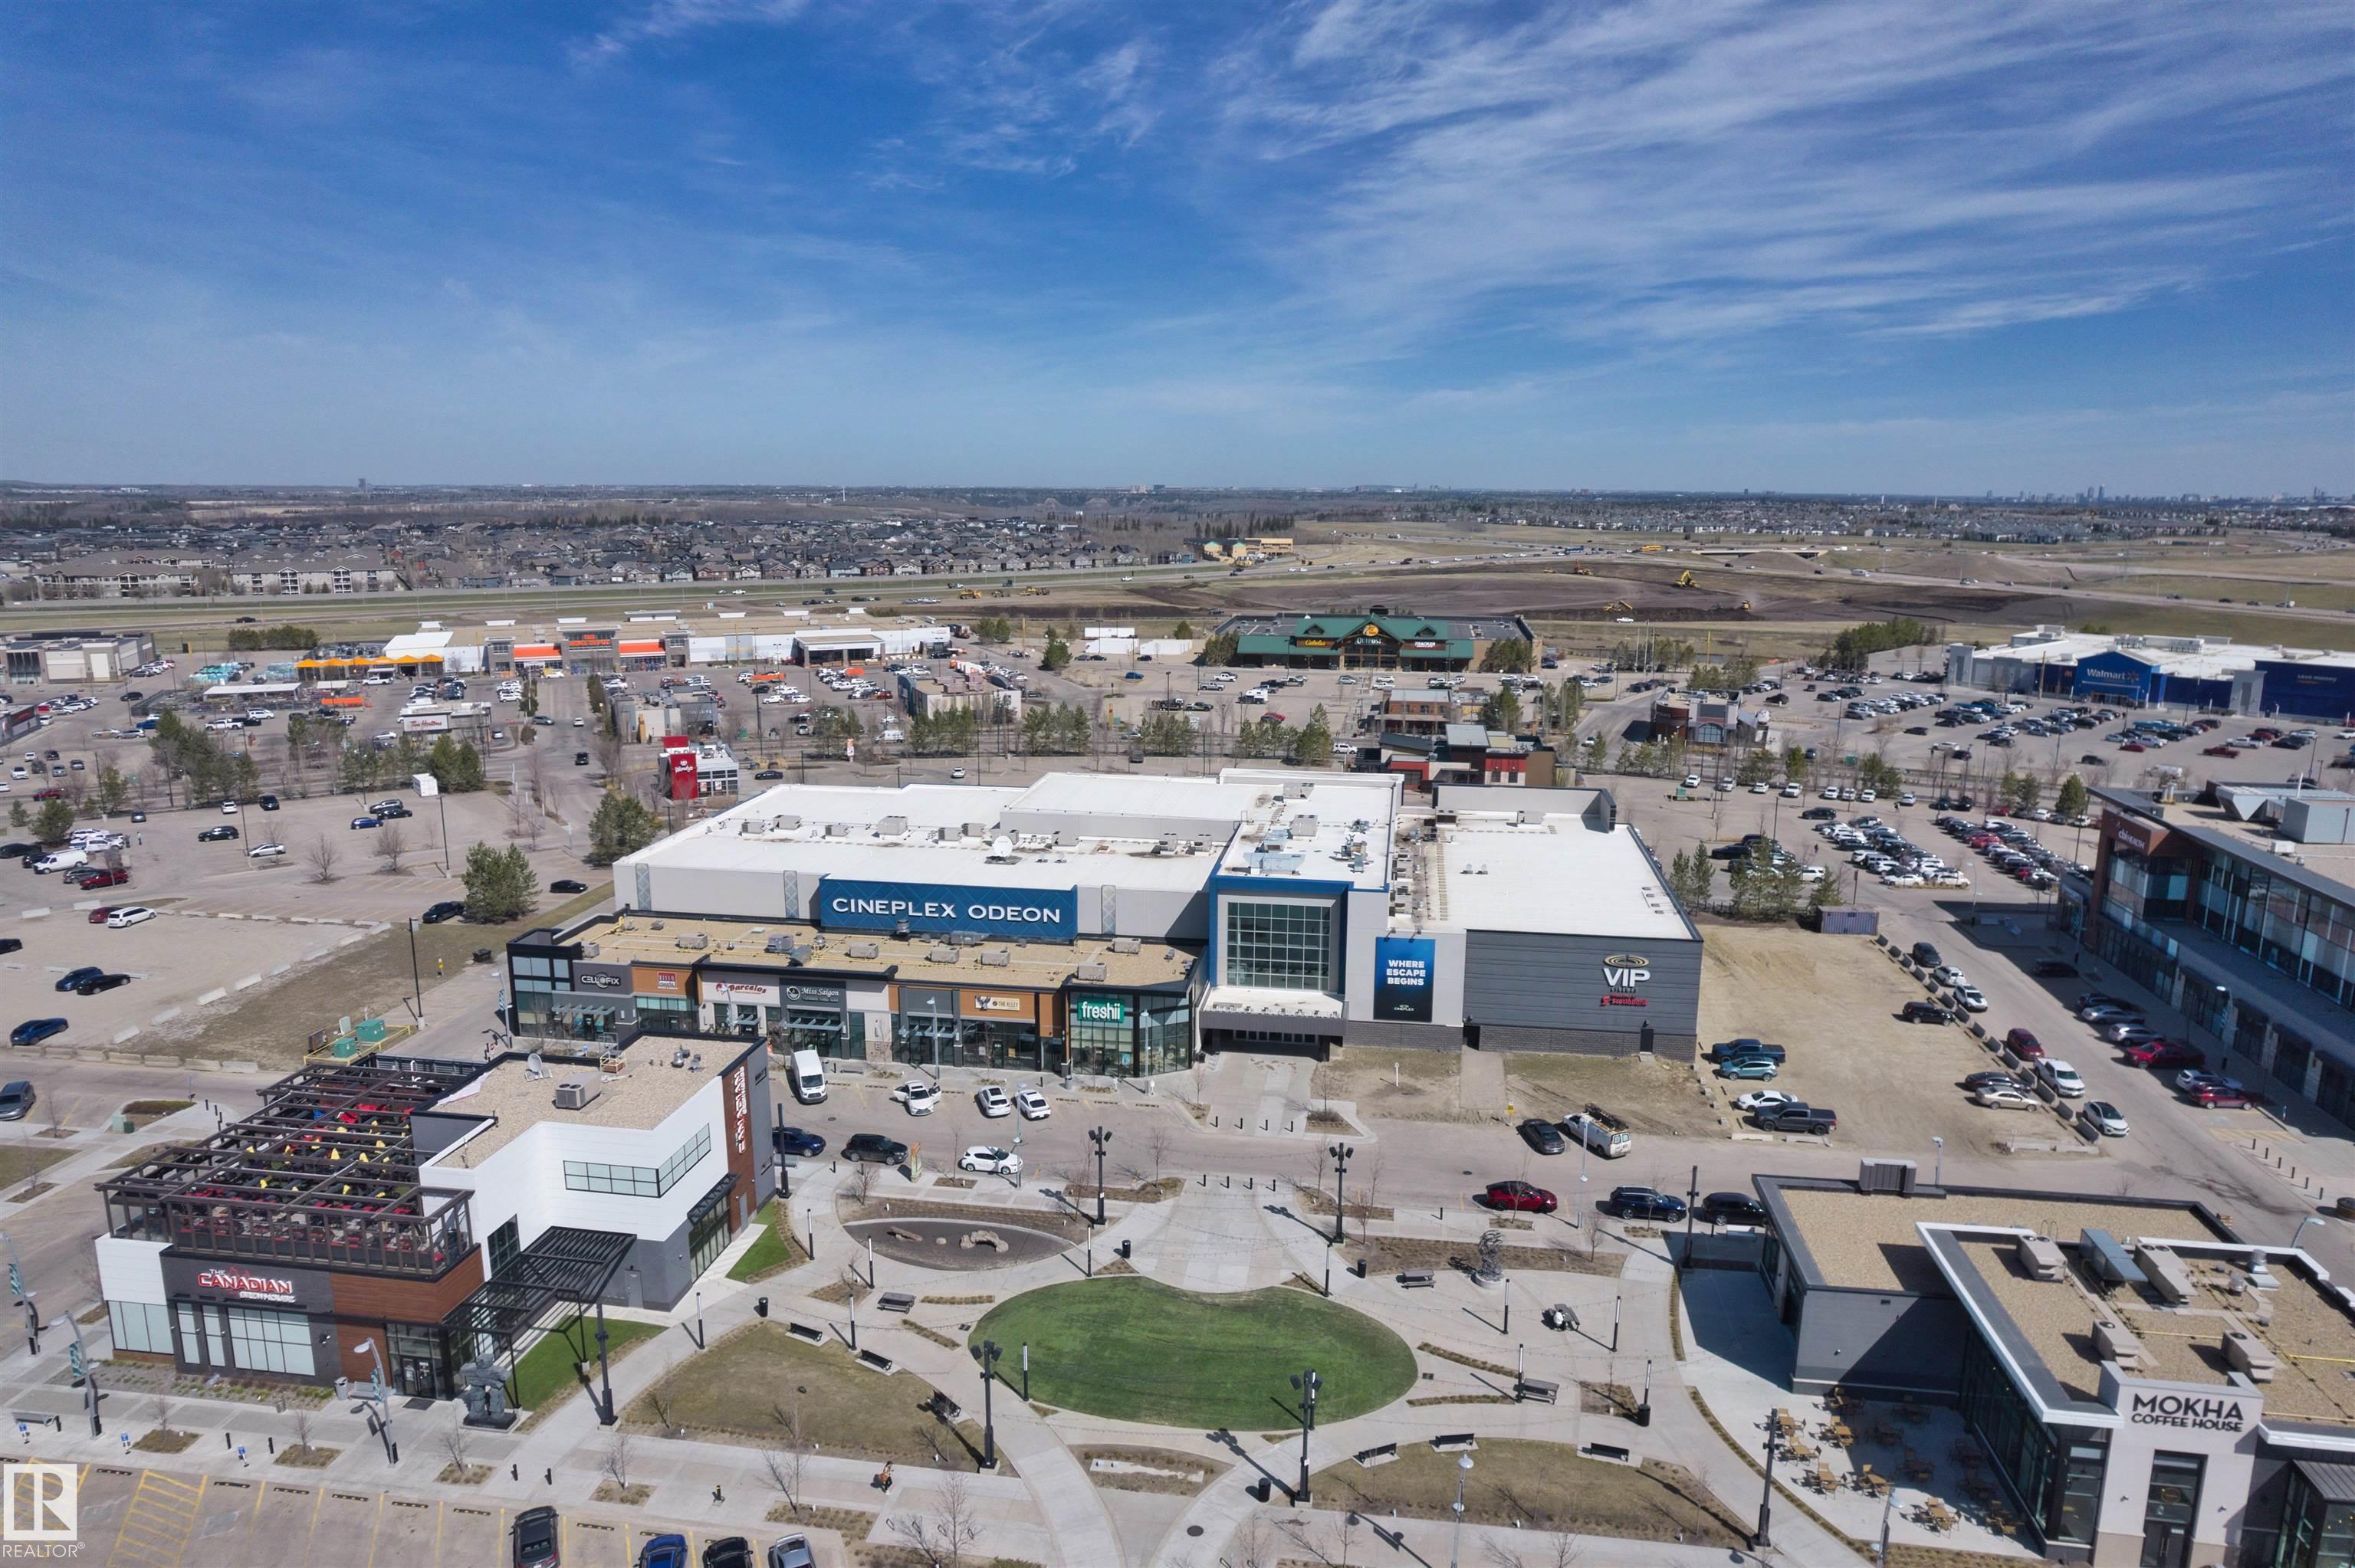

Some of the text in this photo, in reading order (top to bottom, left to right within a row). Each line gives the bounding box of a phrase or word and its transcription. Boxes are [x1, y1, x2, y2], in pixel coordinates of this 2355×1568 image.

[2087, 668, 2125, 680] Walmart
[833, 898, 1060, 923] CINEPLEX ODEON
[1388, 959, 1425, 969] WHERE
[1386, 968, 1427, 977] ESCAPE
[1603, 967, 1650, 988] VIP
[729, 984, 767, 994] Barcelos
[1387, 977, 1424, 986] BEGINS
[817, 989, 839, 998] Saigon
[1082, 1001, 1121, 1020] freshii
[198, 1273, 293, 1294] CANADIAN
[2132, 1393, 2245, 1421] MOKHA
[2131, 1413, 2243, 1432] COFFEE HOUSE
